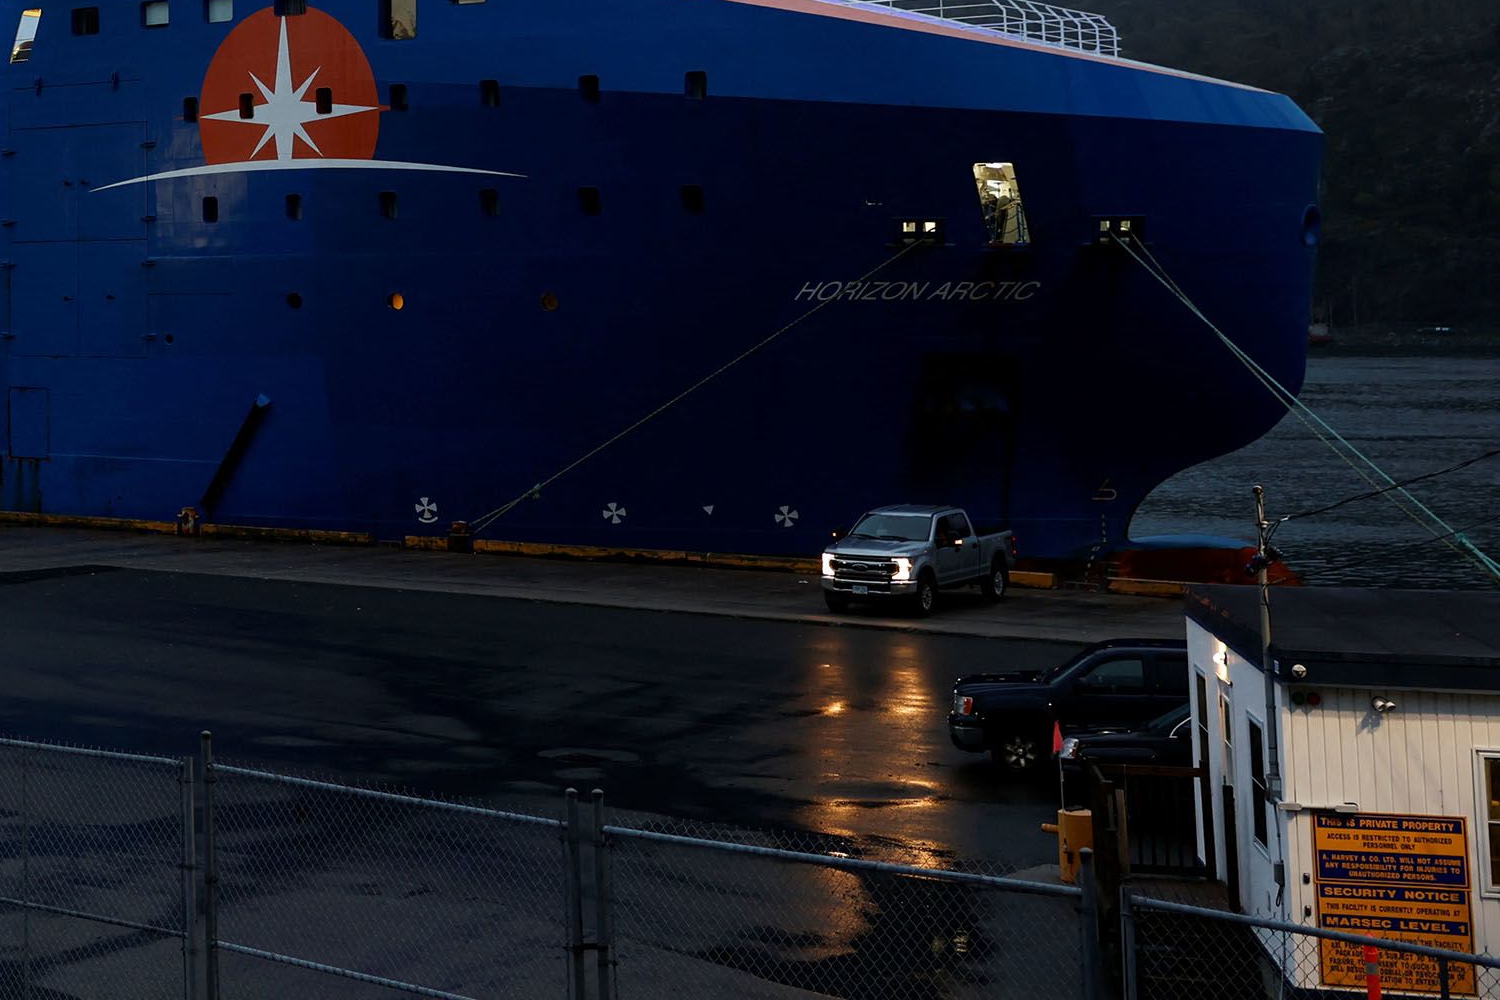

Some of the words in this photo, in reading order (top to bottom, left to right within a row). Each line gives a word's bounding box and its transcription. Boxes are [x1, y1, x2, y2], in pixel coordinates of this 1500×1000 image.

[794, 281, 931, 301] HORIZON
[926, 281, 1041, 301] ARCTIC
[1321, 817, 1342, 826] THIS
[1346, 818, 1356, 828] IS
[1359, 819, 1399, 829] PRIVATE
[1402, 821, 1455, 832] PROPERTY
[1327, 833, 1350, 841] ACCESS
[1361, 834, 1400, 842] RESTRICTED
[1413, 836, 1453, 845] AUTHORIZED
[1363, 842, 1398, 850] PERSONNEL
[1401, 843, 1416, 851] ONLY
[1331, 854, 1359, 862] HARVEY
[1369, 855, 1381, 863] CO.
[1416, 857, 1431, 865] NOT
[1434, 858, 1461, 867] ASSUME
[1342, 862, 1397, 871] RESPONSIBILITY
[1416, 866, 1449, 874] INJURIES
[1451, 867, 1461, 875] TO
[1348, 870, 1400, 879] UNAUTHORIZED
[1402, 873, 1437, 881] PERSONS.
[1323, 887, 1397, 898] SECURITY
[1404, 890, 1460, 902] NOTICE
[1342, 903, 1368, 911] FACILITY
[1379, 905, 1413, 914] CURRENTLY
[1416, 908, 1451, 917] OPERATING
[1326, 916, 1392, 928] MARSEC
[1399, 920, 1450, 932] LEVEL
[1457, 925, 1466, 933] 1
